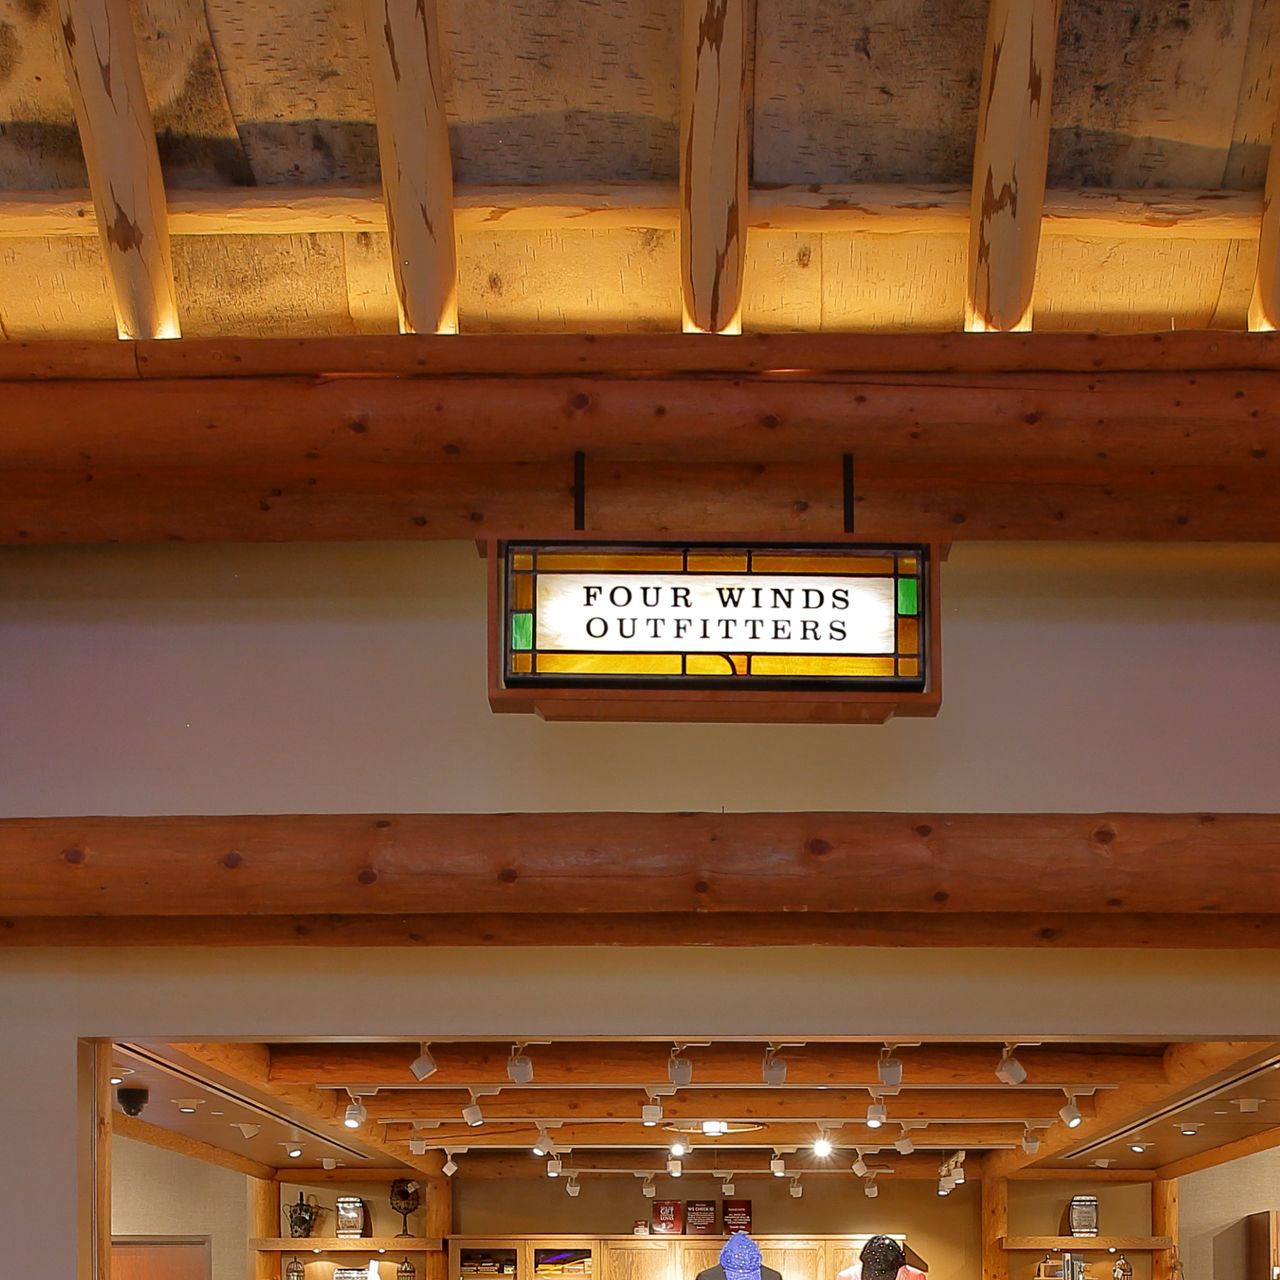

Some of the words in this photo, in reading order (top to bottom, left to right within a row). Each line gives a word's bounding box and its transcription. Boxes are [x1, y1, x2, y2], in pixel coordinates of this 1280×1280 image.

[582, 585, 693, 608] FOUR
[715, 587, 850, 610] WINDS
[585, 616, 847, 641] OUTFITTERS
